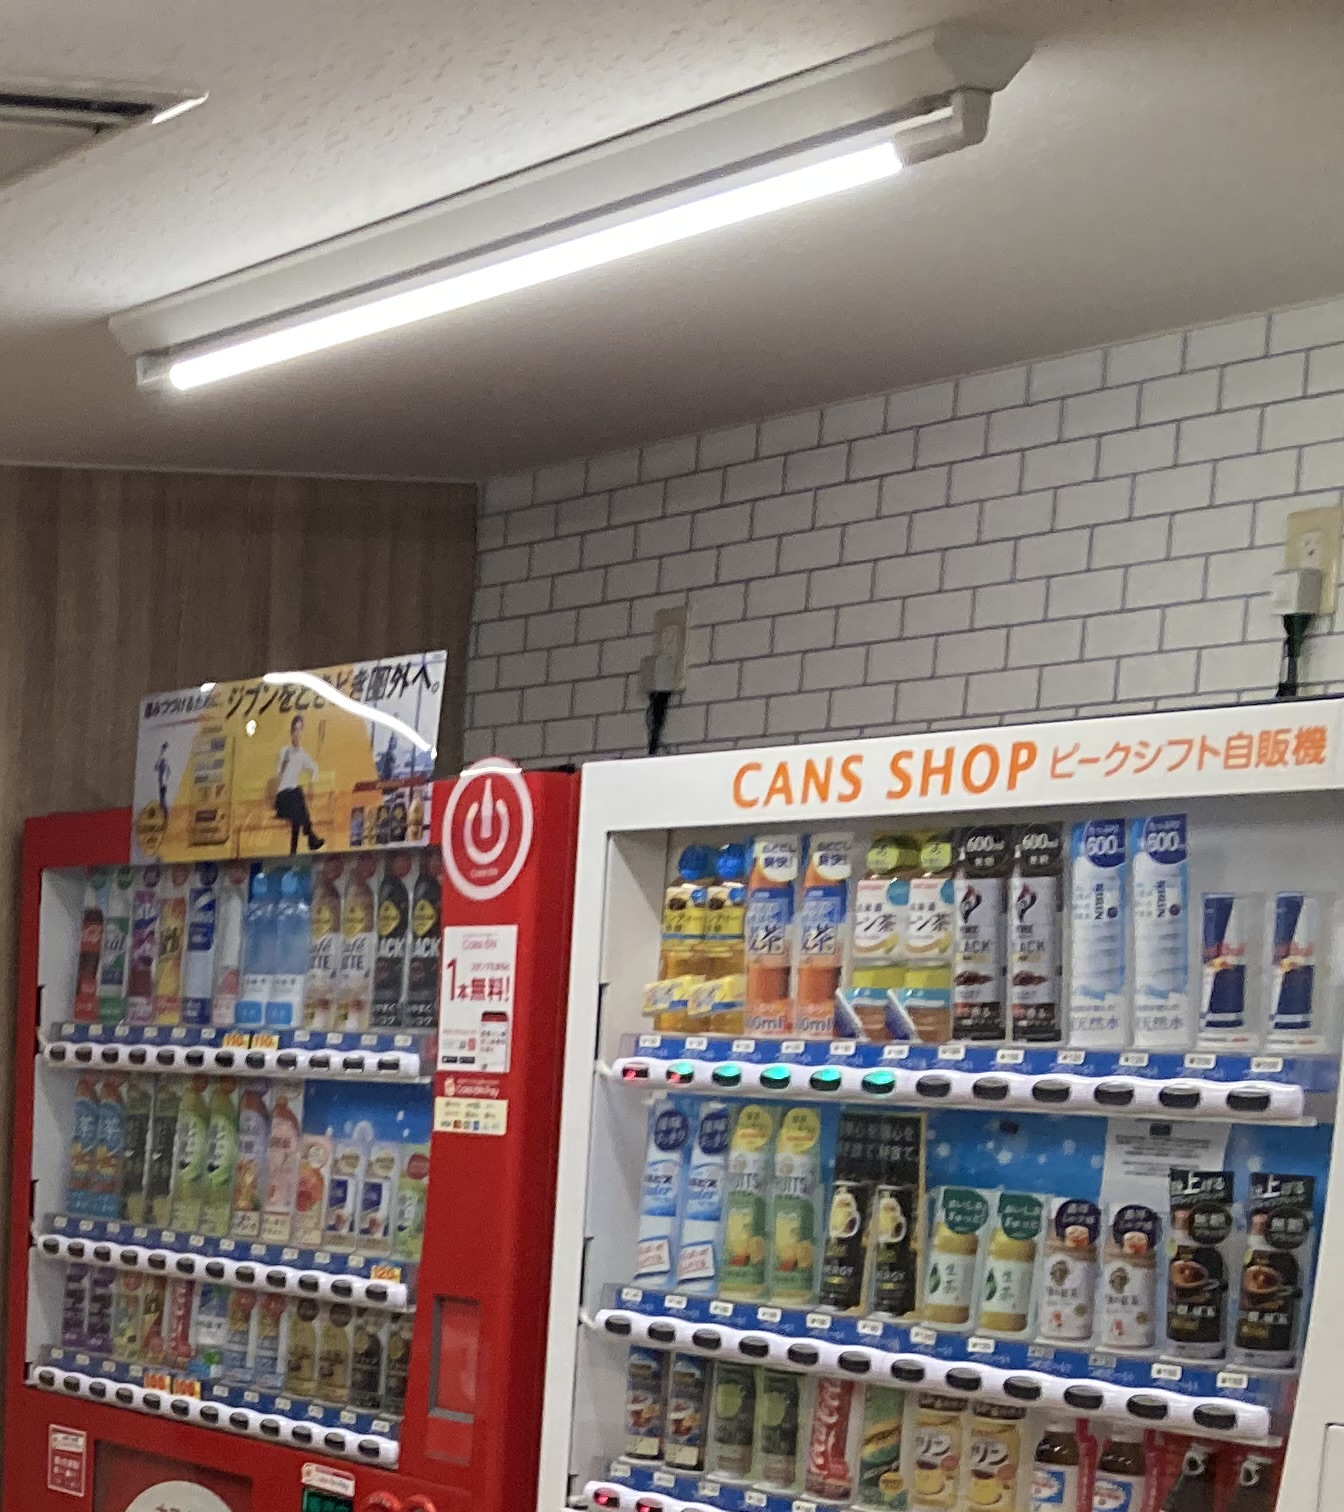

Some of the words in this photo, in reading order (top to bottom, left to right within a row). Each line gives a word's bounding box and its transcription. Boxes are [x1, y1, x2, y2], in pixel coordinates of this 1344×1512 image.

[732, 753, 863, 808] CANS
[887, 740, 1037, 801] SHOP
[1049, 724, 1328, 779] ピークシフト自販機
[446, 958, 510, 1002] 1本無料!
